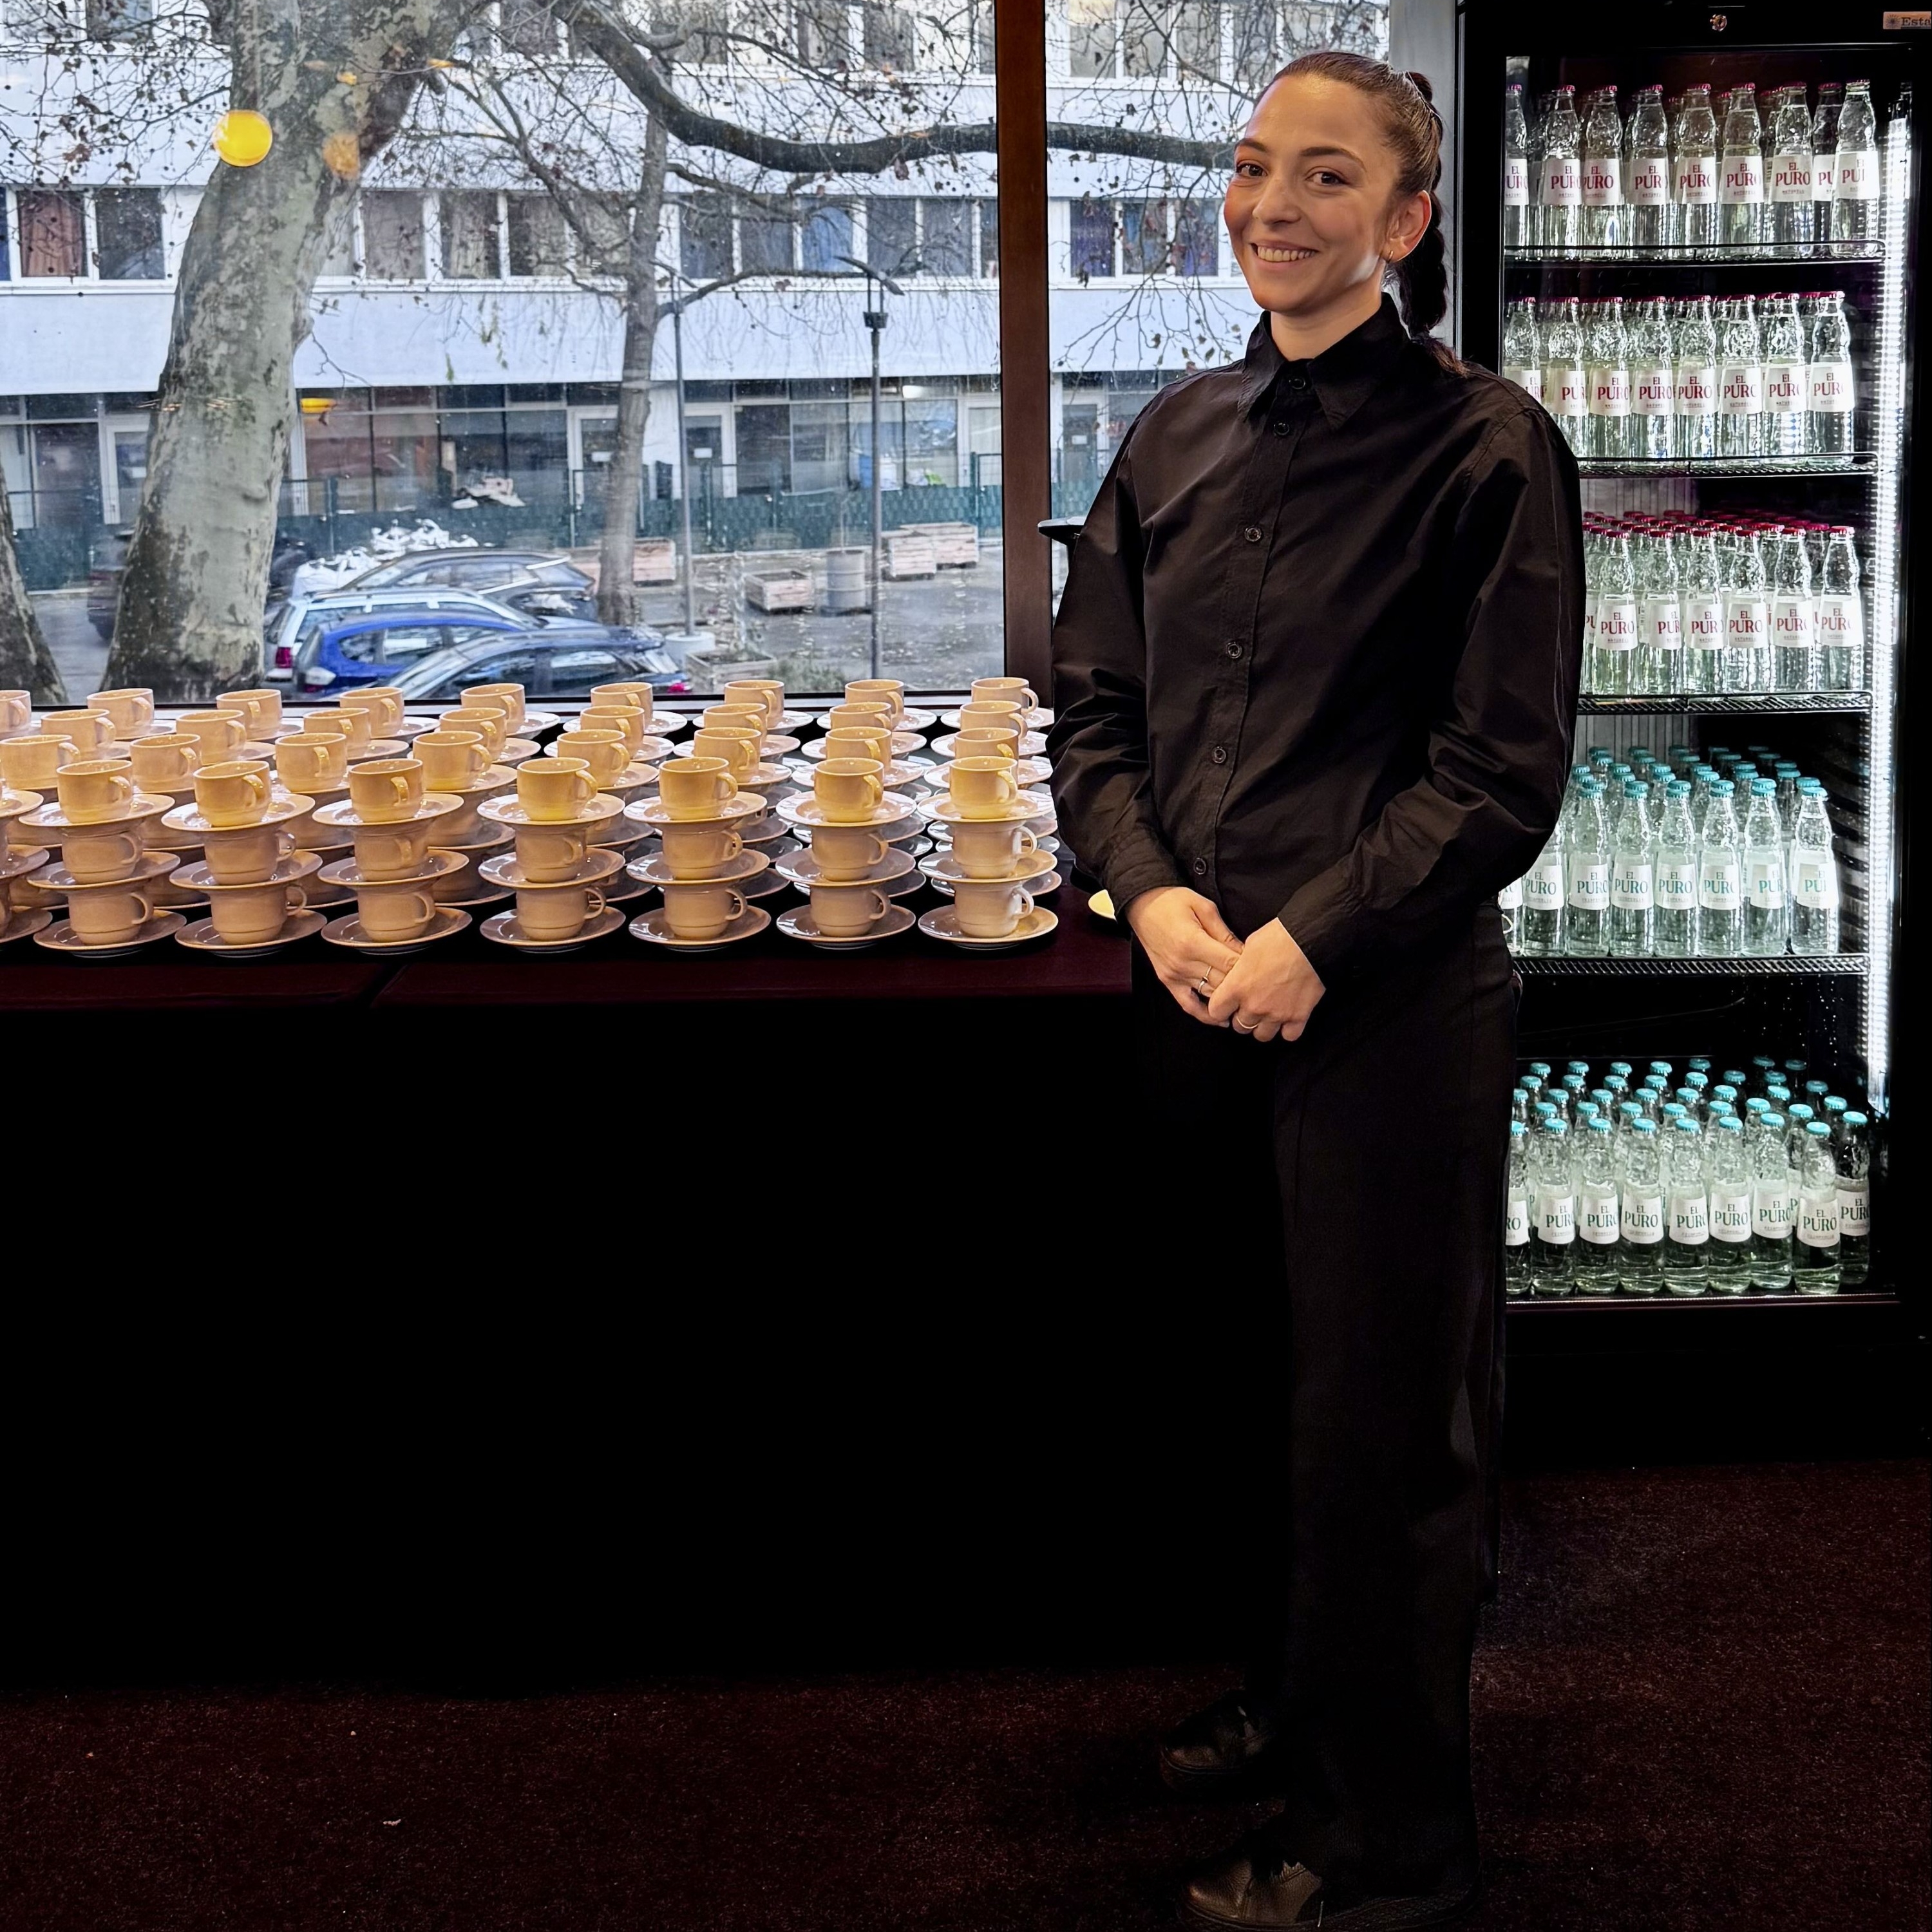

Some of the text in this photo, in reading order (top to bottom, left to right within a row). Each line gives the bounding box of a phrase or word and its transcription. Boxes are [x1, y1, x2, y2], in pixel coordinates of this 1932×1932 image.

[1511, 166, 1519, 174] EL
[1565, 166, 1573, 174] EL
[1591, 166, 1600, 174] EL
[1649, 165, 1658, 174] EL
[1692, 164, 1703, 173] EL
[1740, 163, 1750, 171] EL
[1788, 162, 1799, 171] EL
[1776, 171, 1810, 186] PURO
[1690, 376, 1700, 384] EL
[1736, 375, 1746, 383] EL
[1782, 374, 1791, 382] EL
[1639, 386, 1672, 399] PURO
[1678, 385, 1712, 399] PURO
[1613, 612, 1623, 620] EL
[1740, 611, 1750, 619] EL
[1790, 609, 1799, 617] EL
[1833, 607, 1842, 616] EL
[1601, 621, 1634, 634] PURO
[1729, 620, 1763, 633] PURO
[1535, 871, 1544, 880] EL
[1591, 872, 1598, 880] EL
[1671, 871, 1680, 880] EL
[1716, 871, 1725, 880] EL
[1526, 878, 1556, 895] PURO
[1615, 878, 1647, 894] PURO
[1659, 878, 1692, 894] PURO
[1773, 1200, 1781, 1209] EL
[1855, 1198, 1864, 1207] EL
[1560, 1206, 1567, 1214] EL
[1601, 1206, 1609, 1214] EL
[1636, 1205, 1646, 1213] EL
[1727, 1204, 1737, 1212] EL
[1816, 1209, 1826, 1218] EL
[1625, 1211, 1658, 1227] PURO
[1715, 1211, 1748, 1226] PURO
[1803, 1216, 1837, 1231] PURO
